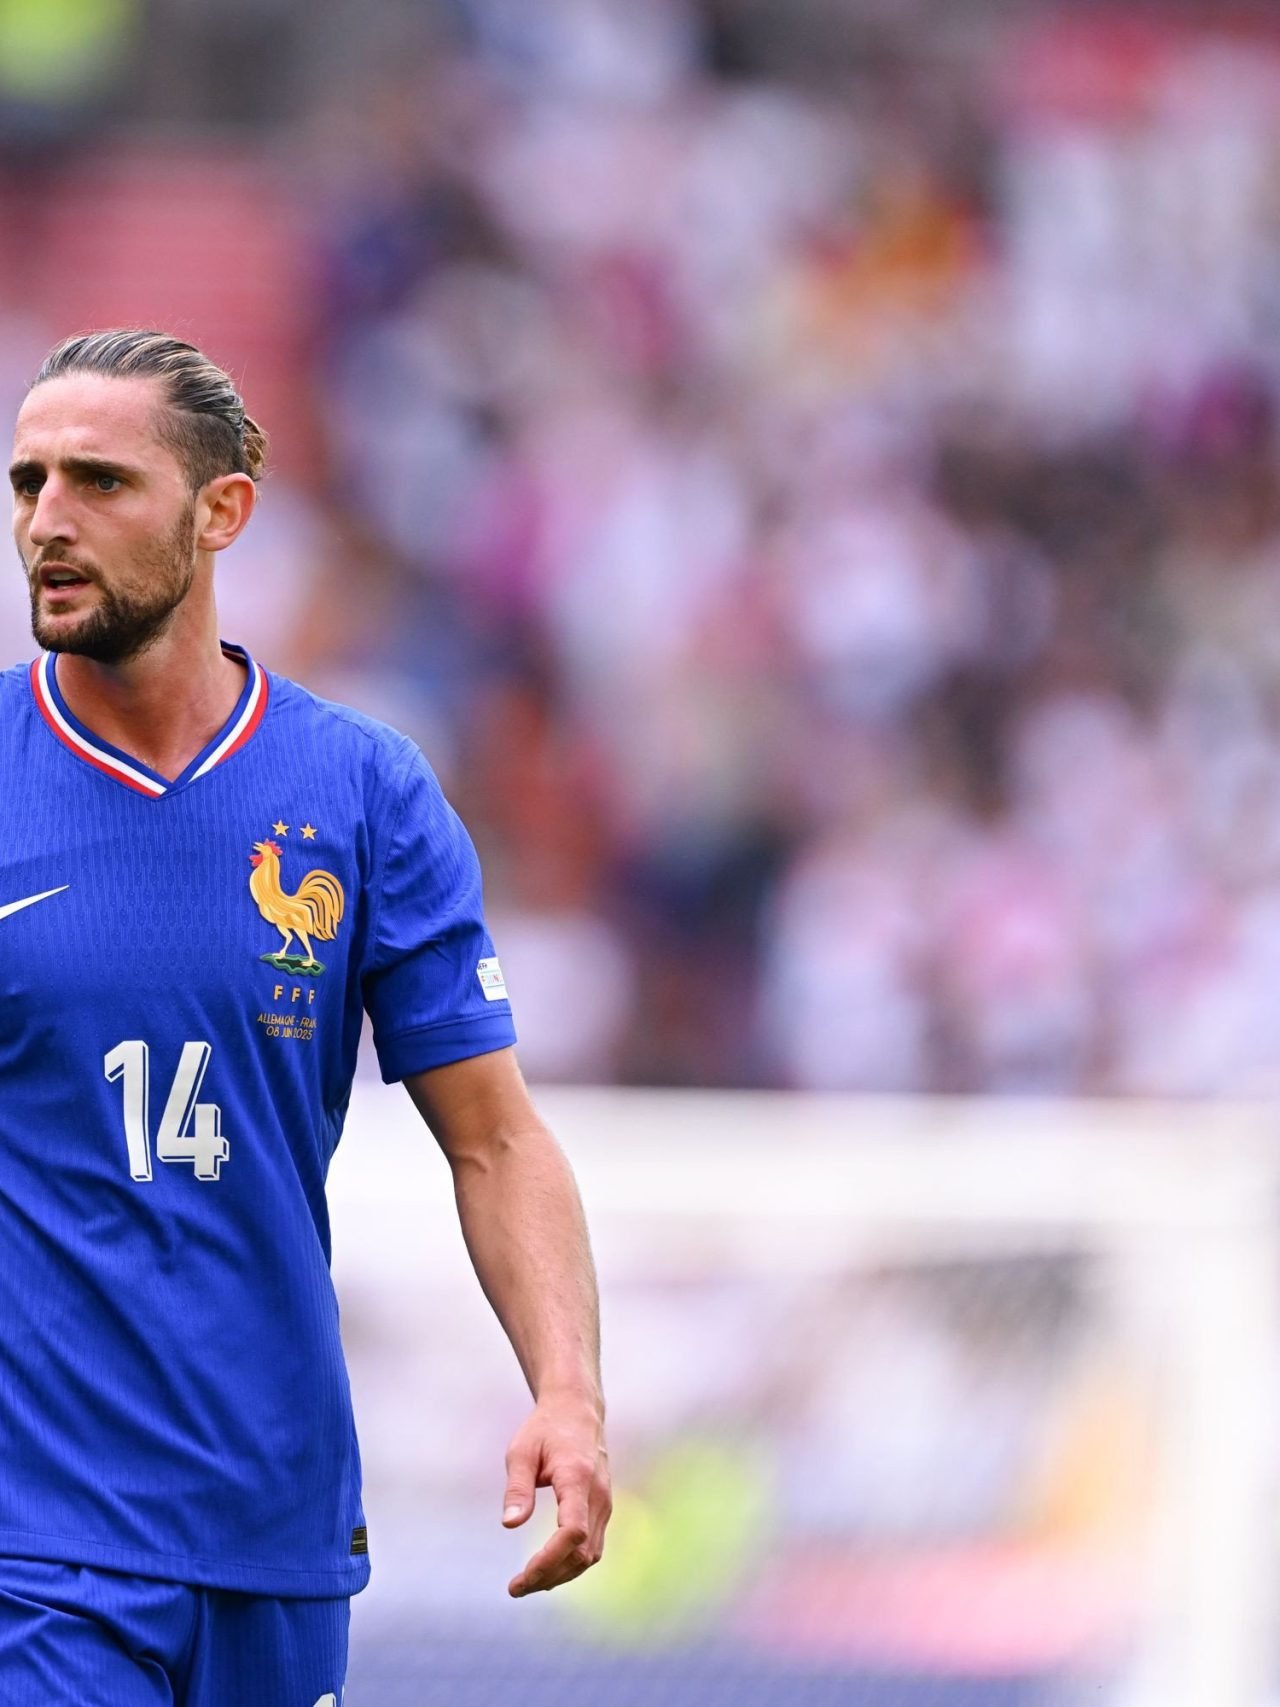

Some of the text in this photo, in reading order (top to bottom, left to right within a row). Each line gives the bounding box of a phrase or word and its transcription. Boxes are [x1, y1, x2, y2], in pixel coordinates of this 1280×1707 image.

[257, 1013, 295, 1026] ALLEMAGNE
[292, 1027, 313, 1040] 2025
[104, 1040, 229, 1182] 14
